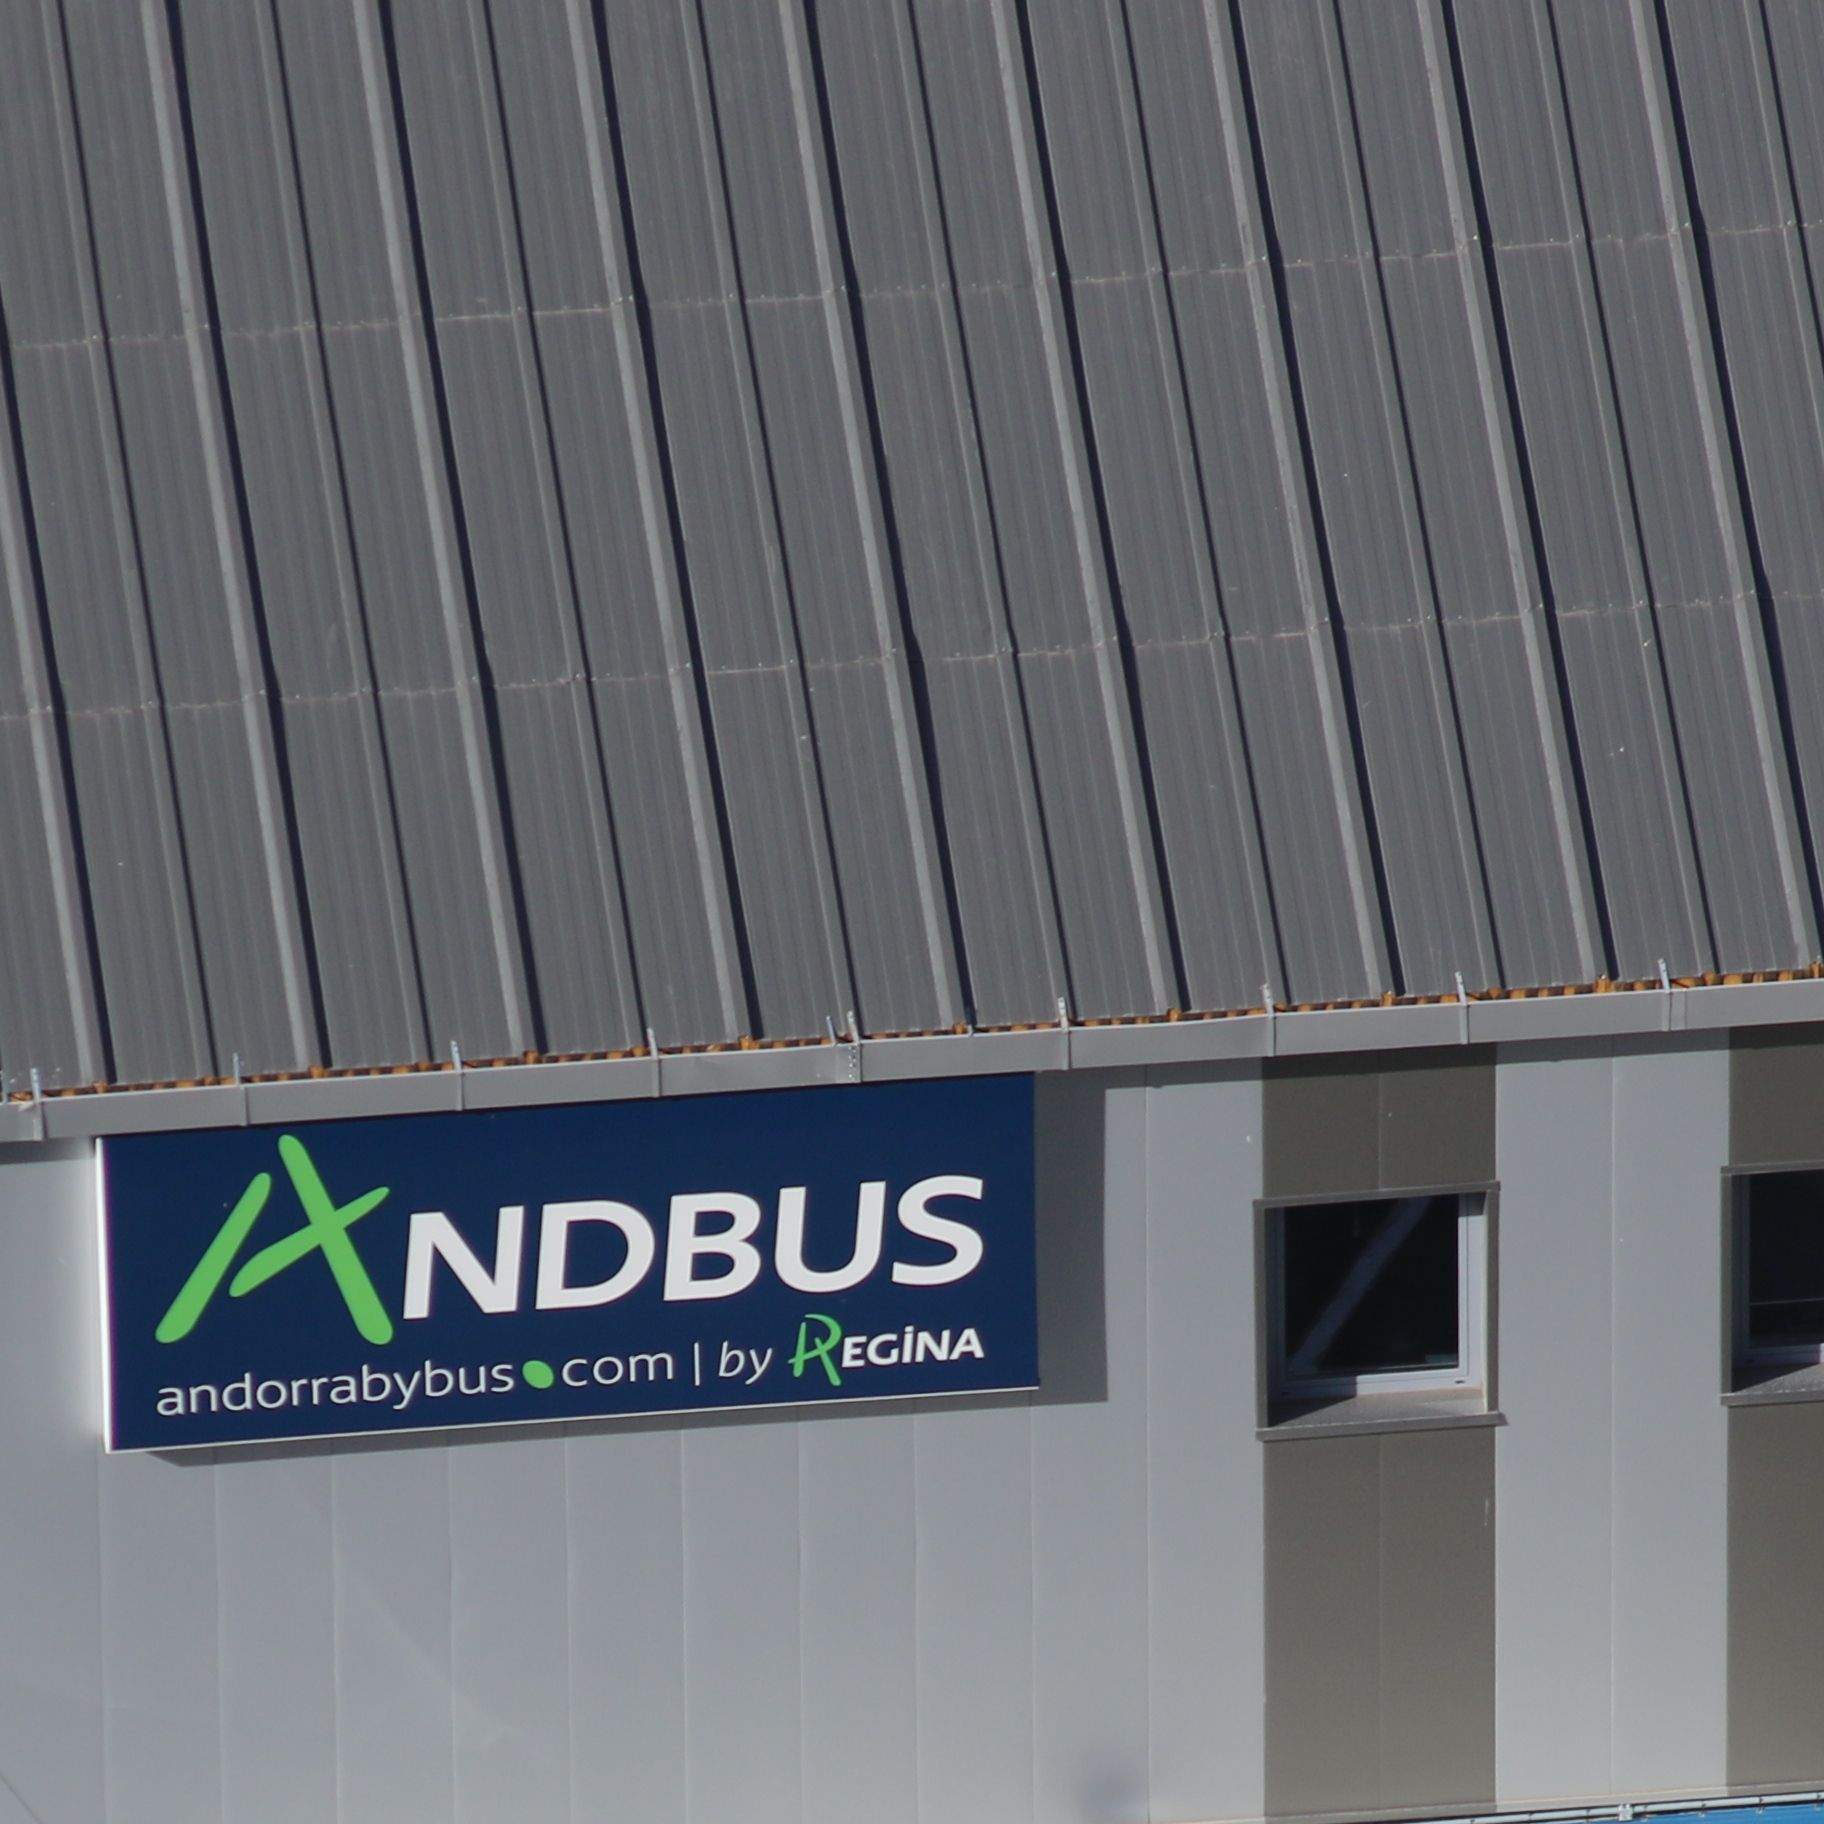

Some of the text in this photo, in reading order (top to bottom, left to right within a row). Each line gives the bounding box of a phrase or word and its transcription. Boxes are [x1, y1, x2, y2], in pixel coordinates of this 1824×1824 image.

[156, 1134, 984, 1344] ANDBUS
[156, 1346, 675, 1416] andorrabybus.com
[718, 1340, 773, 1386] by
